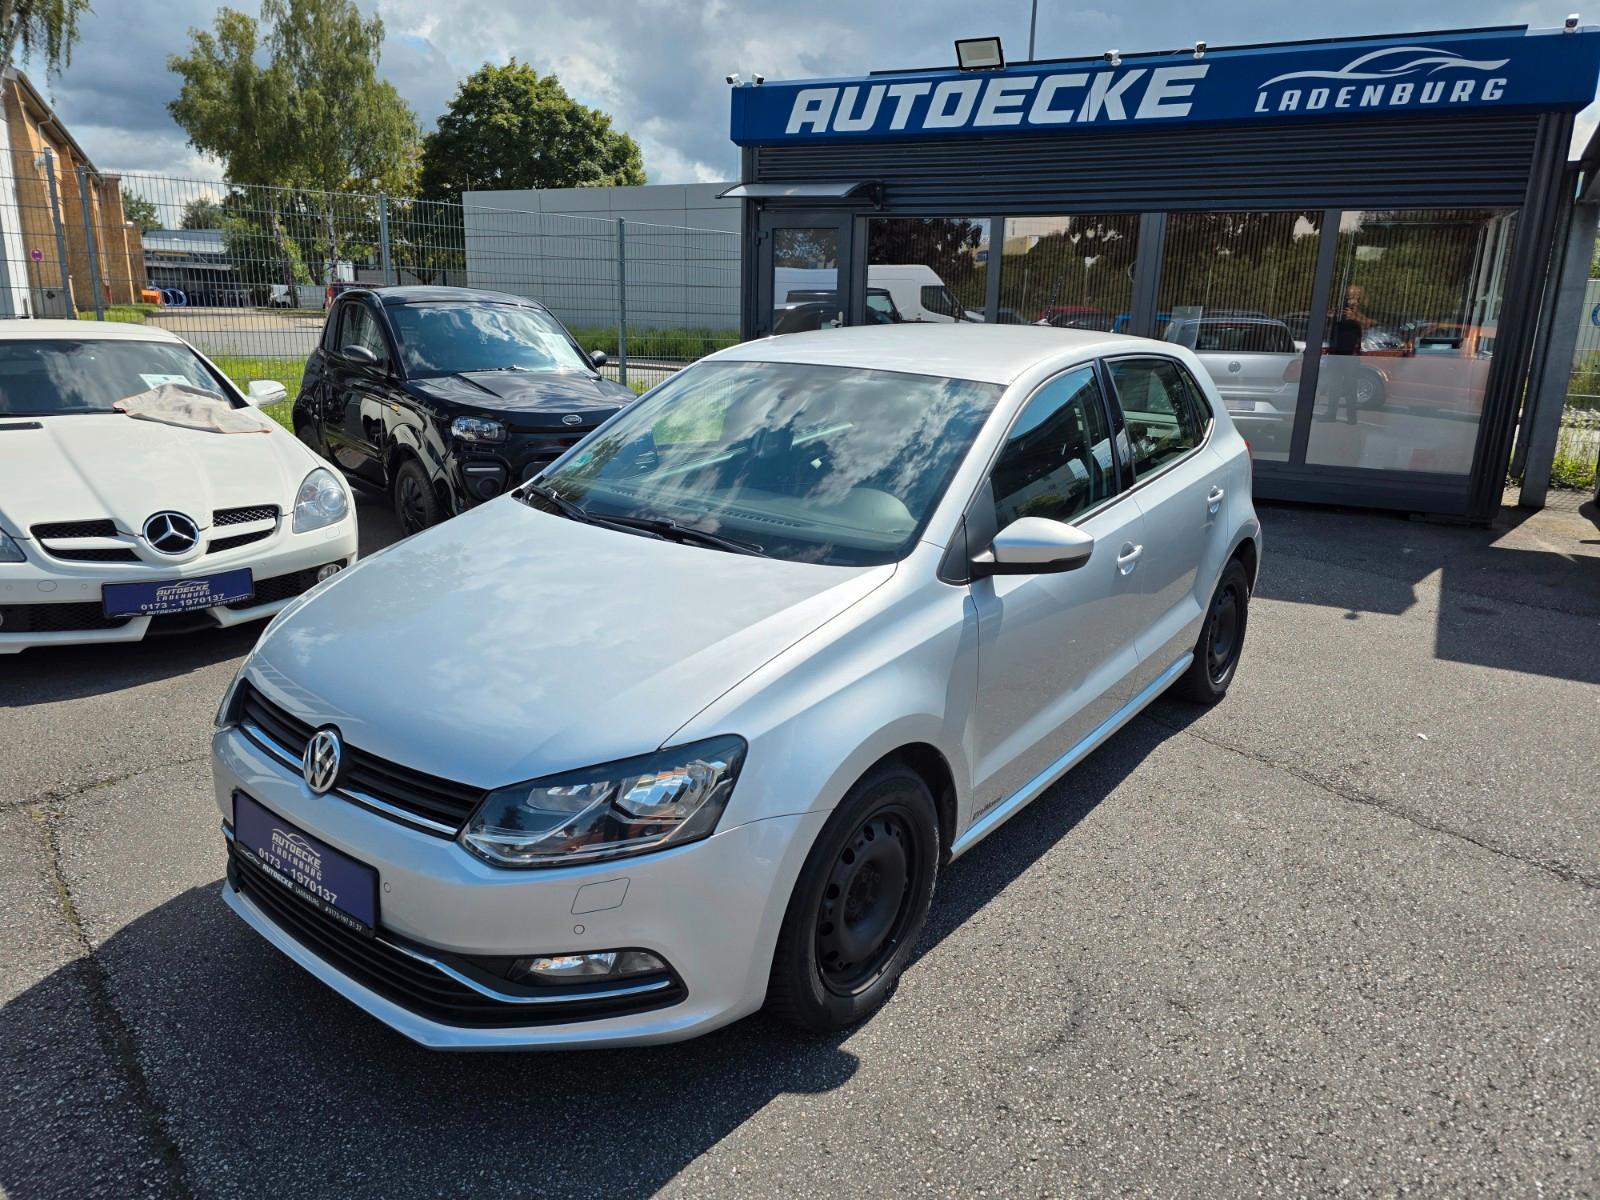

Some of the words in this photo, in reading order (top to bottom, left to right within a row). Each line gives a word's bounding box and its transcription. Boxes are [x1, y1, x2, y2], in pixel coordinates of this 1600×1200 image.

[785, 64, 1210, 134] AUTOECKE
[1254, 78, 1508, 113] LADENBURG
[140, 602, 168, 611] 0173
[179, 593, 225, 607] 1970137
[156, 583, 210, 596] AUTOECKE
[156, 590, 211, 602] LADENBURG
[272, 832, 322, 870] AUTOECKE
[272, 844, 322, 881] LADENBURG
[258, 847, 281, 869] 0173
[290, 868, 338, 904] 1970137
[262, 863, 293, 889] AUTOECKE
